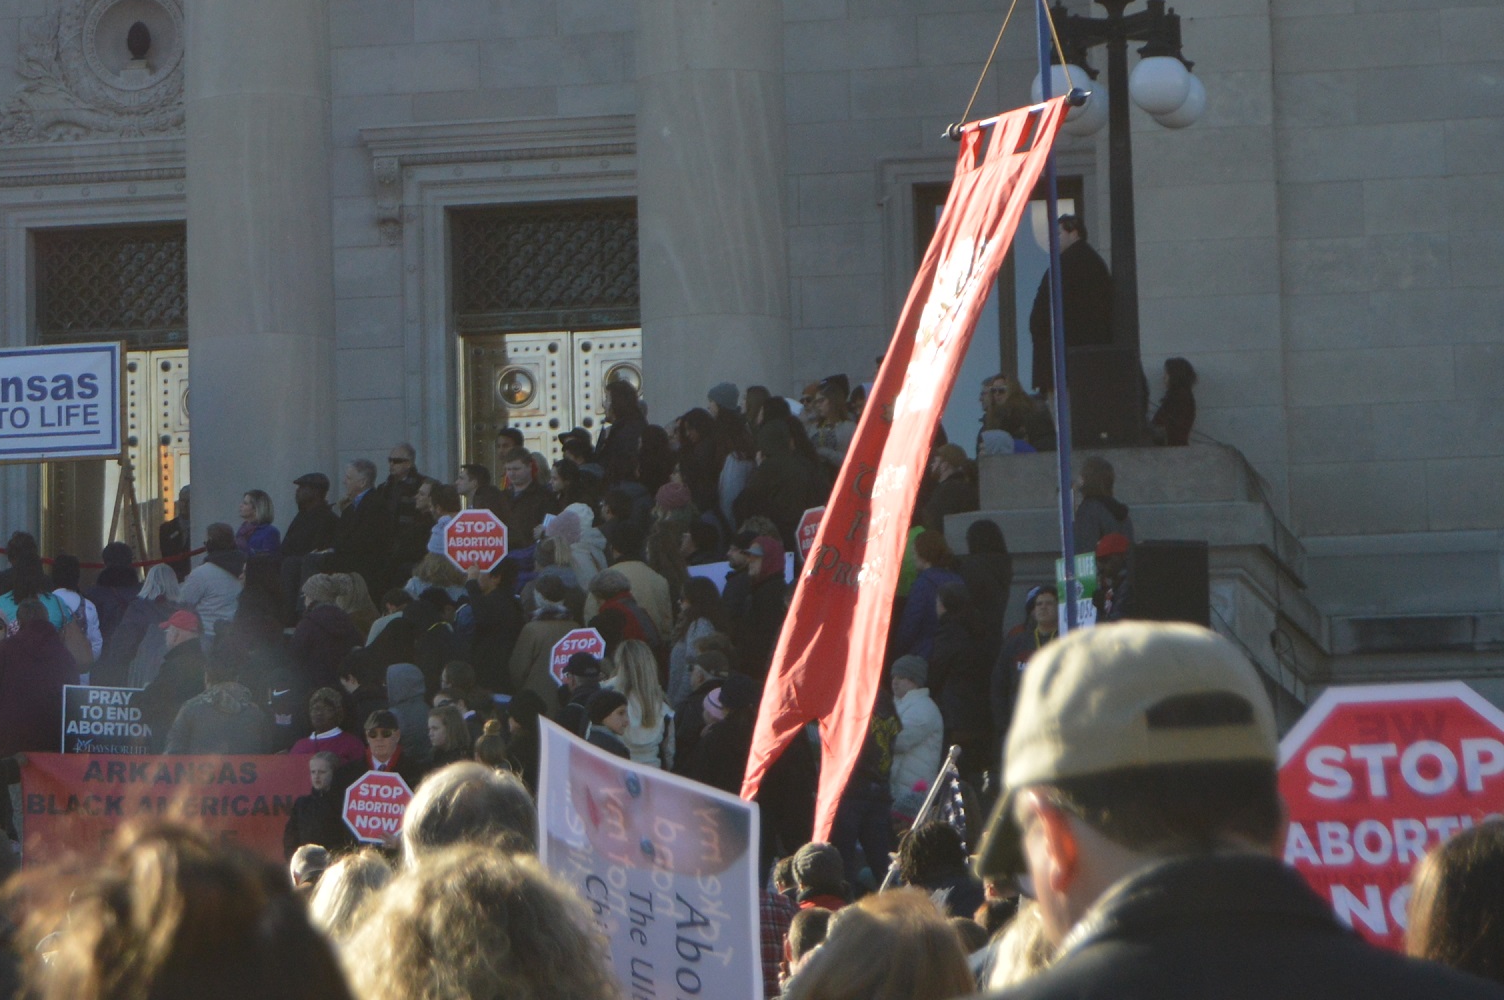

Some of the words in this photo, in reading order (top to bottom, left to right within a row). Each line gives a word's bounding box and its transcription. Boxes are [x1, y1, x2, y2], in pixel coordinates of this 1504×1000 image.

[40, 404, 99, 428] LIFE
[455, 521, 496, 533] STOP
[449, 537, 504, 547] ABORTION
[457, 551, 495, 562] NOW
[562, 638, 597, 650] STOP
[89, 690, 133, 705] PRAY
[80, 705, 103, 720] TO
[107, 707, 142, 721] END
[83, 761, 257, 785] ARKANSAS
[1304, 737, 1504, 799] STOP
[359, 784, 403, 799] STOP
[27, 794, 124, 816] BLACK
[356, 815, 398, 831] NOW
[629, 884, 654, 946] The
